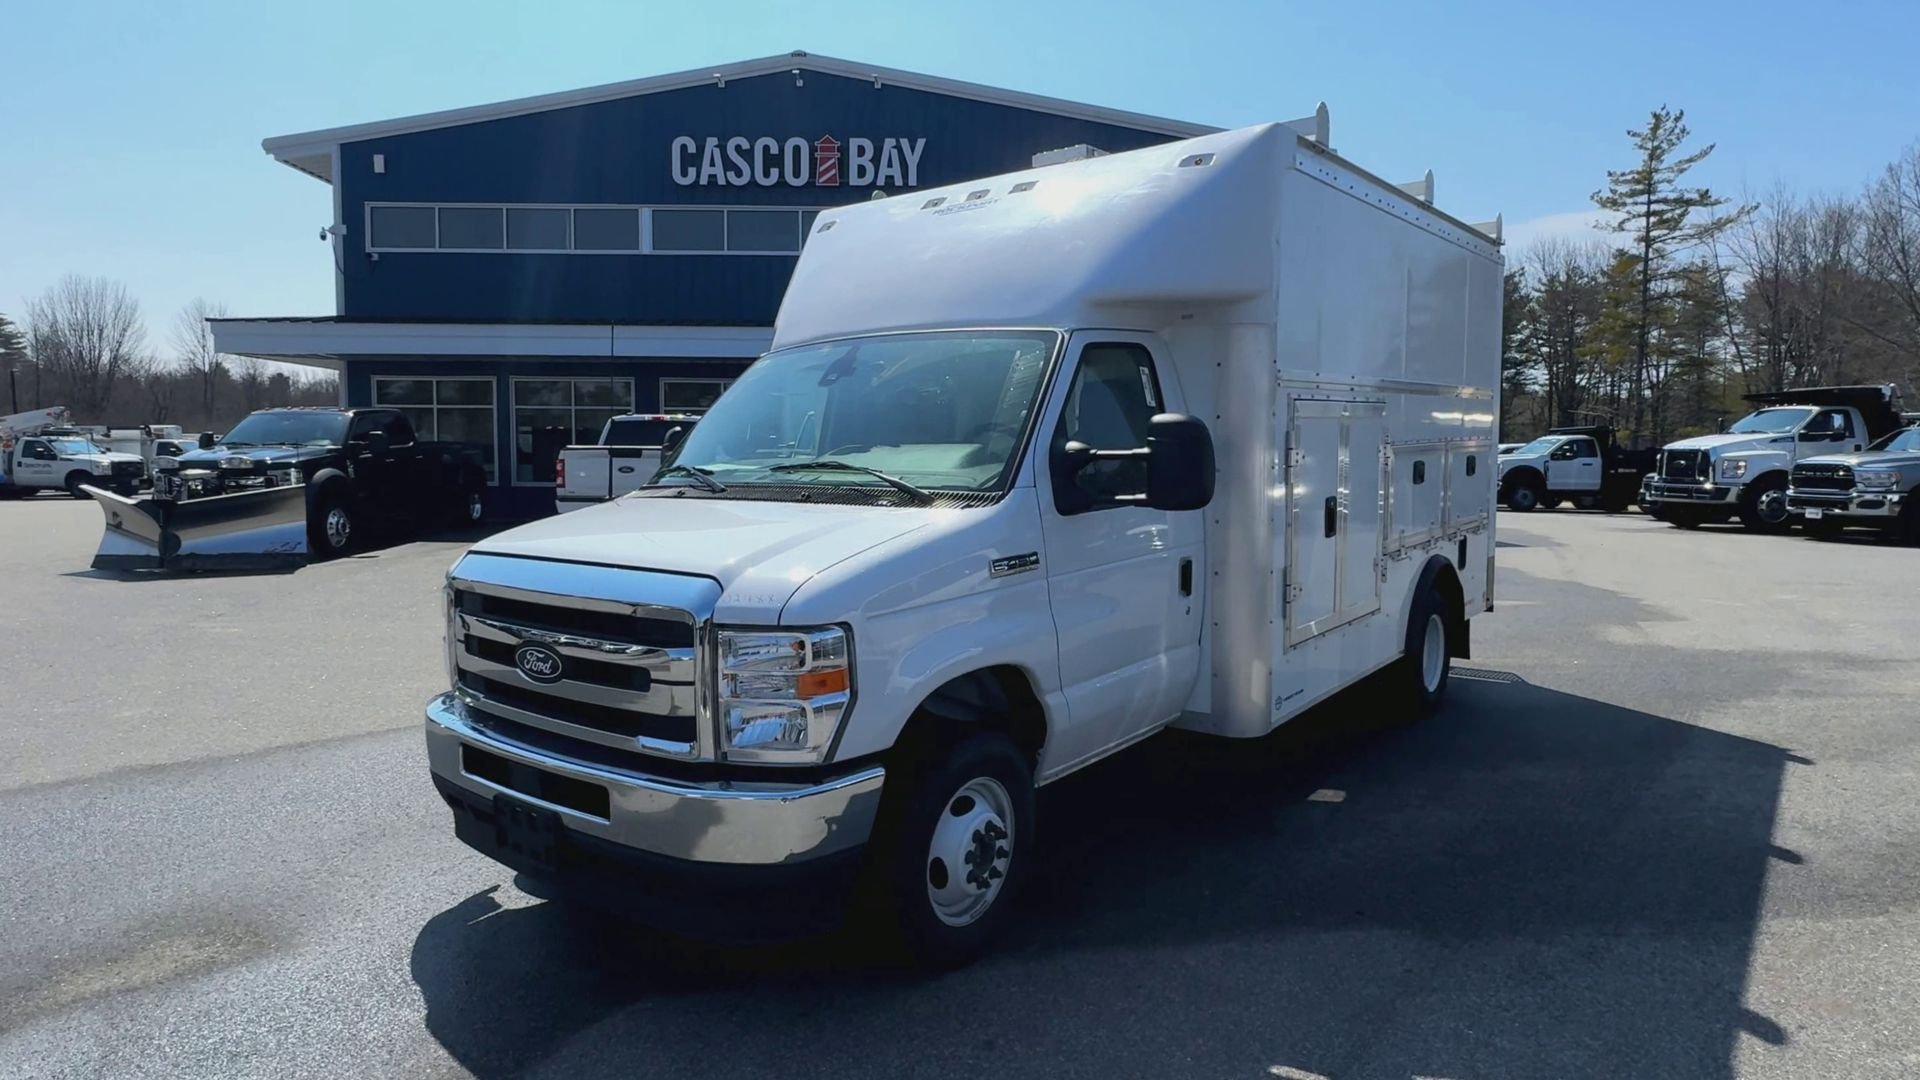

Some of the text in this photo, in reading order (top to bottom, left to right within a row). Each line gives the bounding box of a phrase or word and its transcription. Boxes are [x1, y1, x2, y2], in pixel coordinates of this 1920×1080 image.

[671, 135, 927, 187] CASCO BAY
[523, 649, 553, 674] Ford
